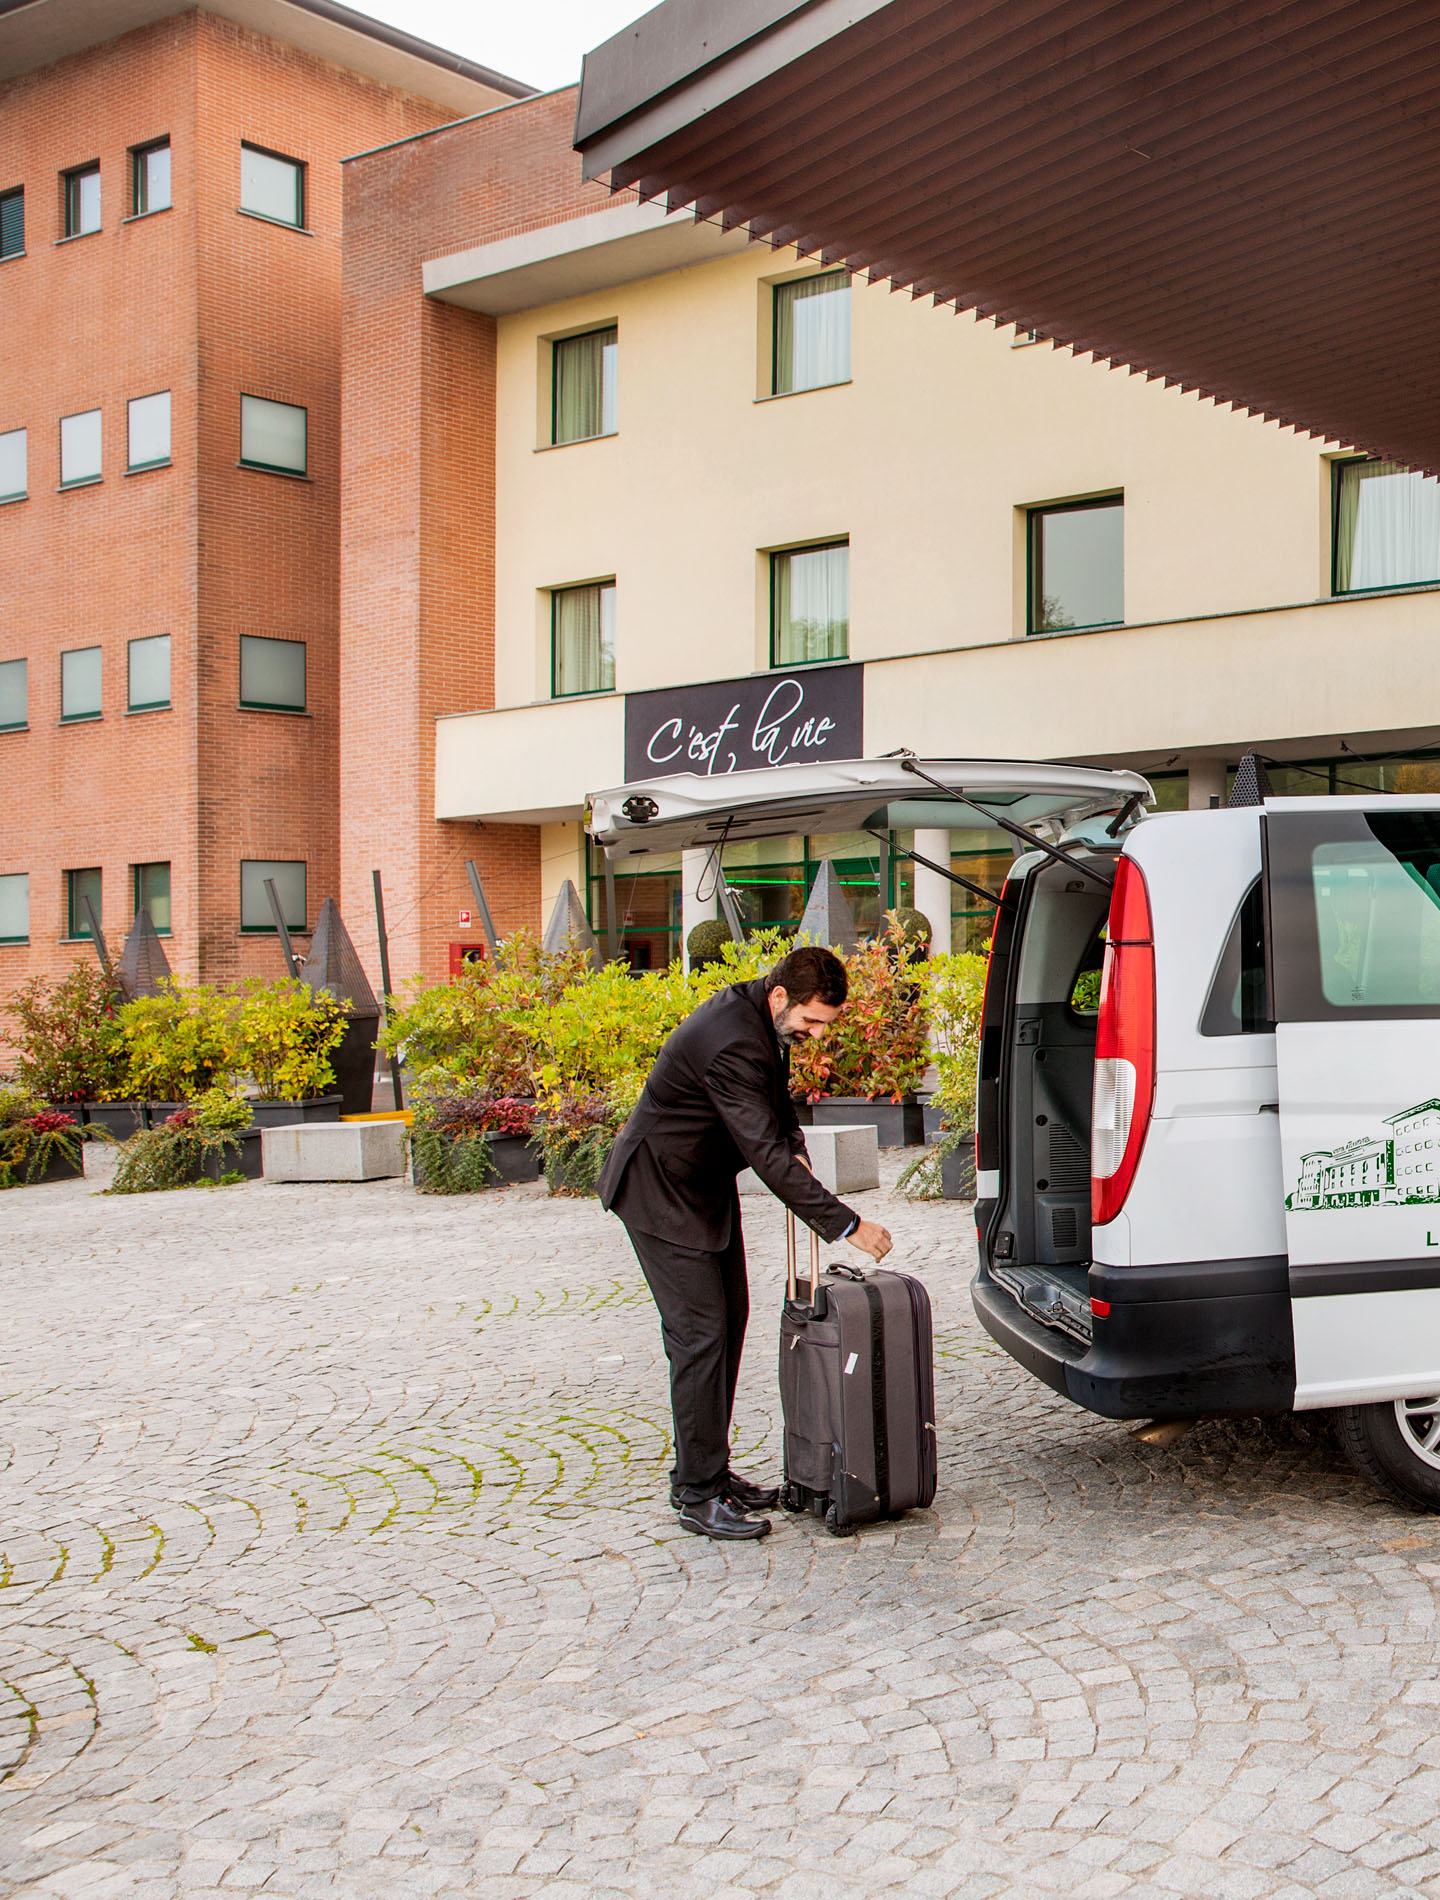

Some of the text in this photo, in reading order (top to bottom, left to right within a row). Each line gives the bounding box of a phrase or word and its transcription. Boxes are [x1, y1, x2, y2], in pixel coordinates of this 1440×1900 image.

[646, 678, 836, 775] C'est la vie
